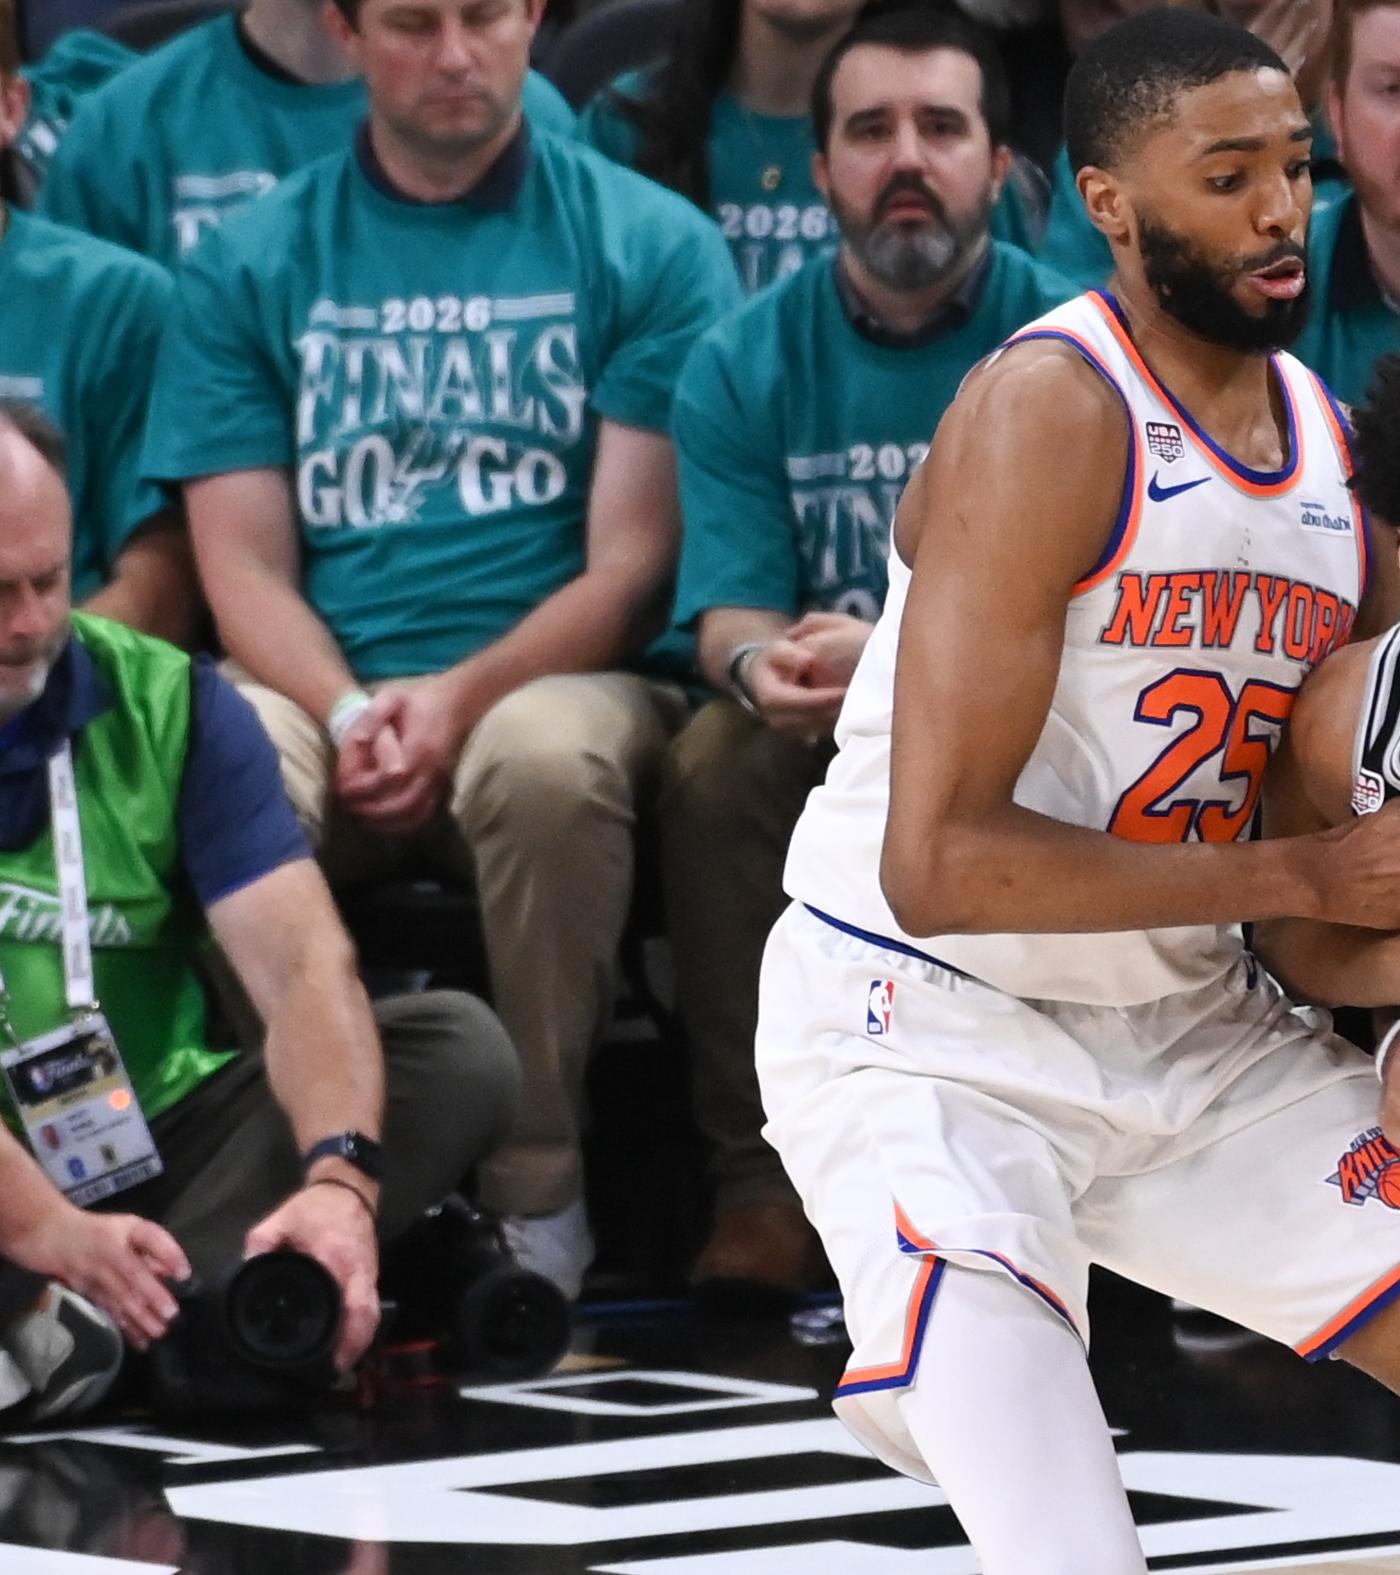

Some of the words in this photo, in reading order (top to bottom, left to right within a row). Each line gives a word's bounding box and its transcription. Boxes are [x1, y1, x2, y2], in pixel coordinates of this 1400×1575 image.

[718, 203, 829, 240] 2026
[381, 296, 492, 334] 2026
[294, 325, 588, 445] FINALS
[1148, 425, 1179, 438] USA
[1150, 442, 1184, 456] 250
[1097, 569, 1251, 650] NEW
[1105, 667, 1299, 844] 25
